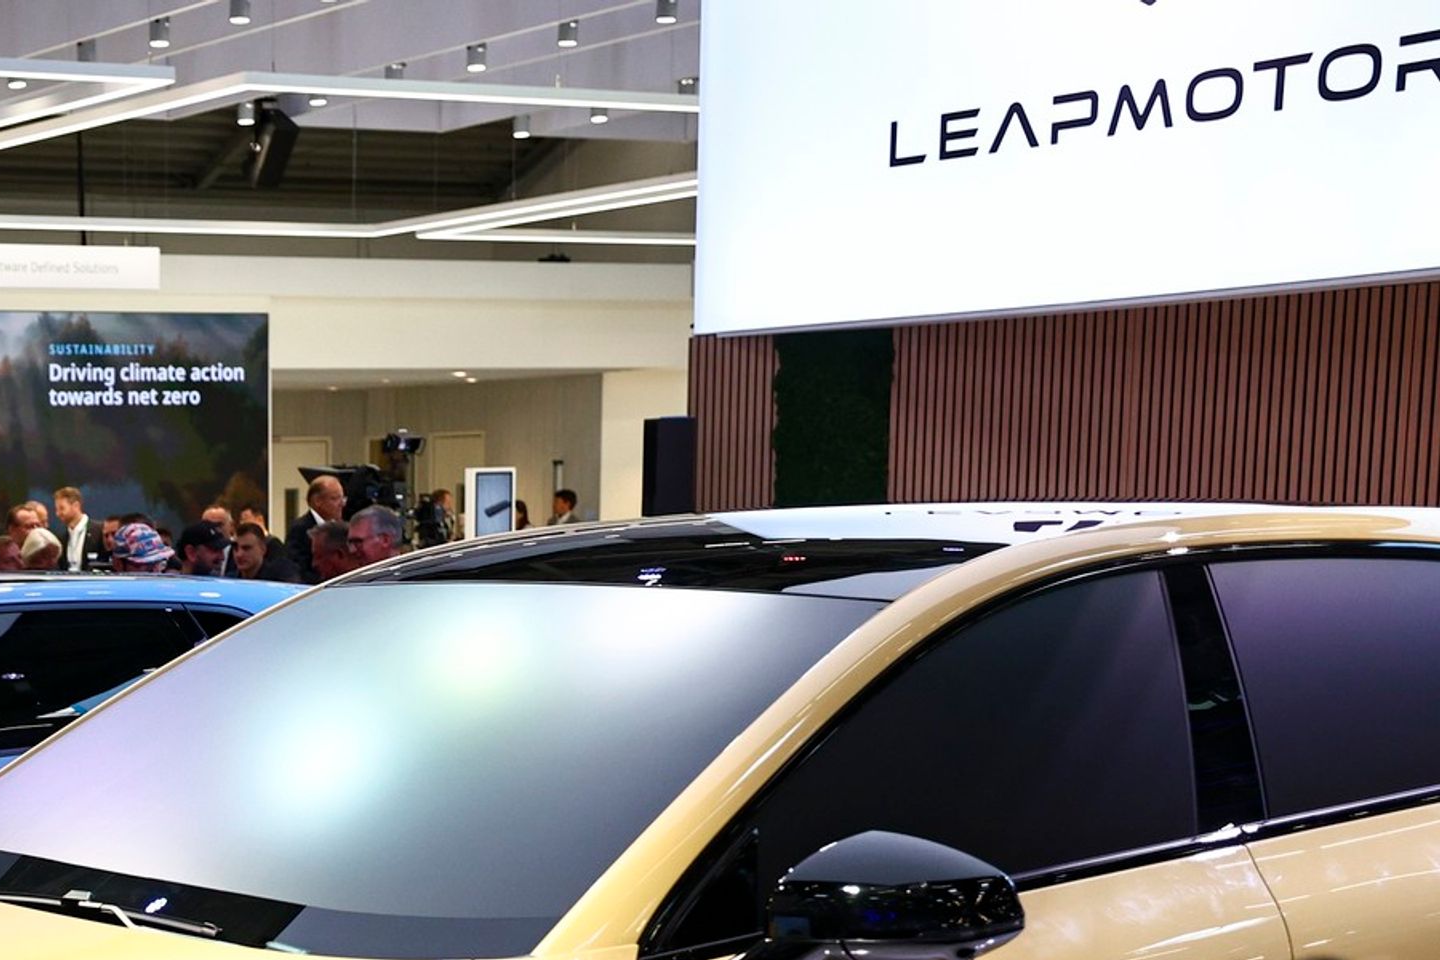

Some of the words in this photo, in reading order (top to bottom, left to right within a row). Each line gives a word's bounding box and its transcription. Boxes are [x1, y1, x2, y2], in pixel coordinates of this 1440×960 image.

[889, 29, 1440, 168] LEAPMOTOR
[30, 261, 70, 274] Defined
[73, 261, 119, 275] Solutions
[48, 343, 156, 356] SUSTAINABILITY
[48, 362, 116, 387] Driving
[119, 362, 187, 382] climate
[190, 362, 246, 383] action
[48, 386, 124, 407] towards
[127, 388, 160, 407] net
[162, 390, 202, 407] zero
